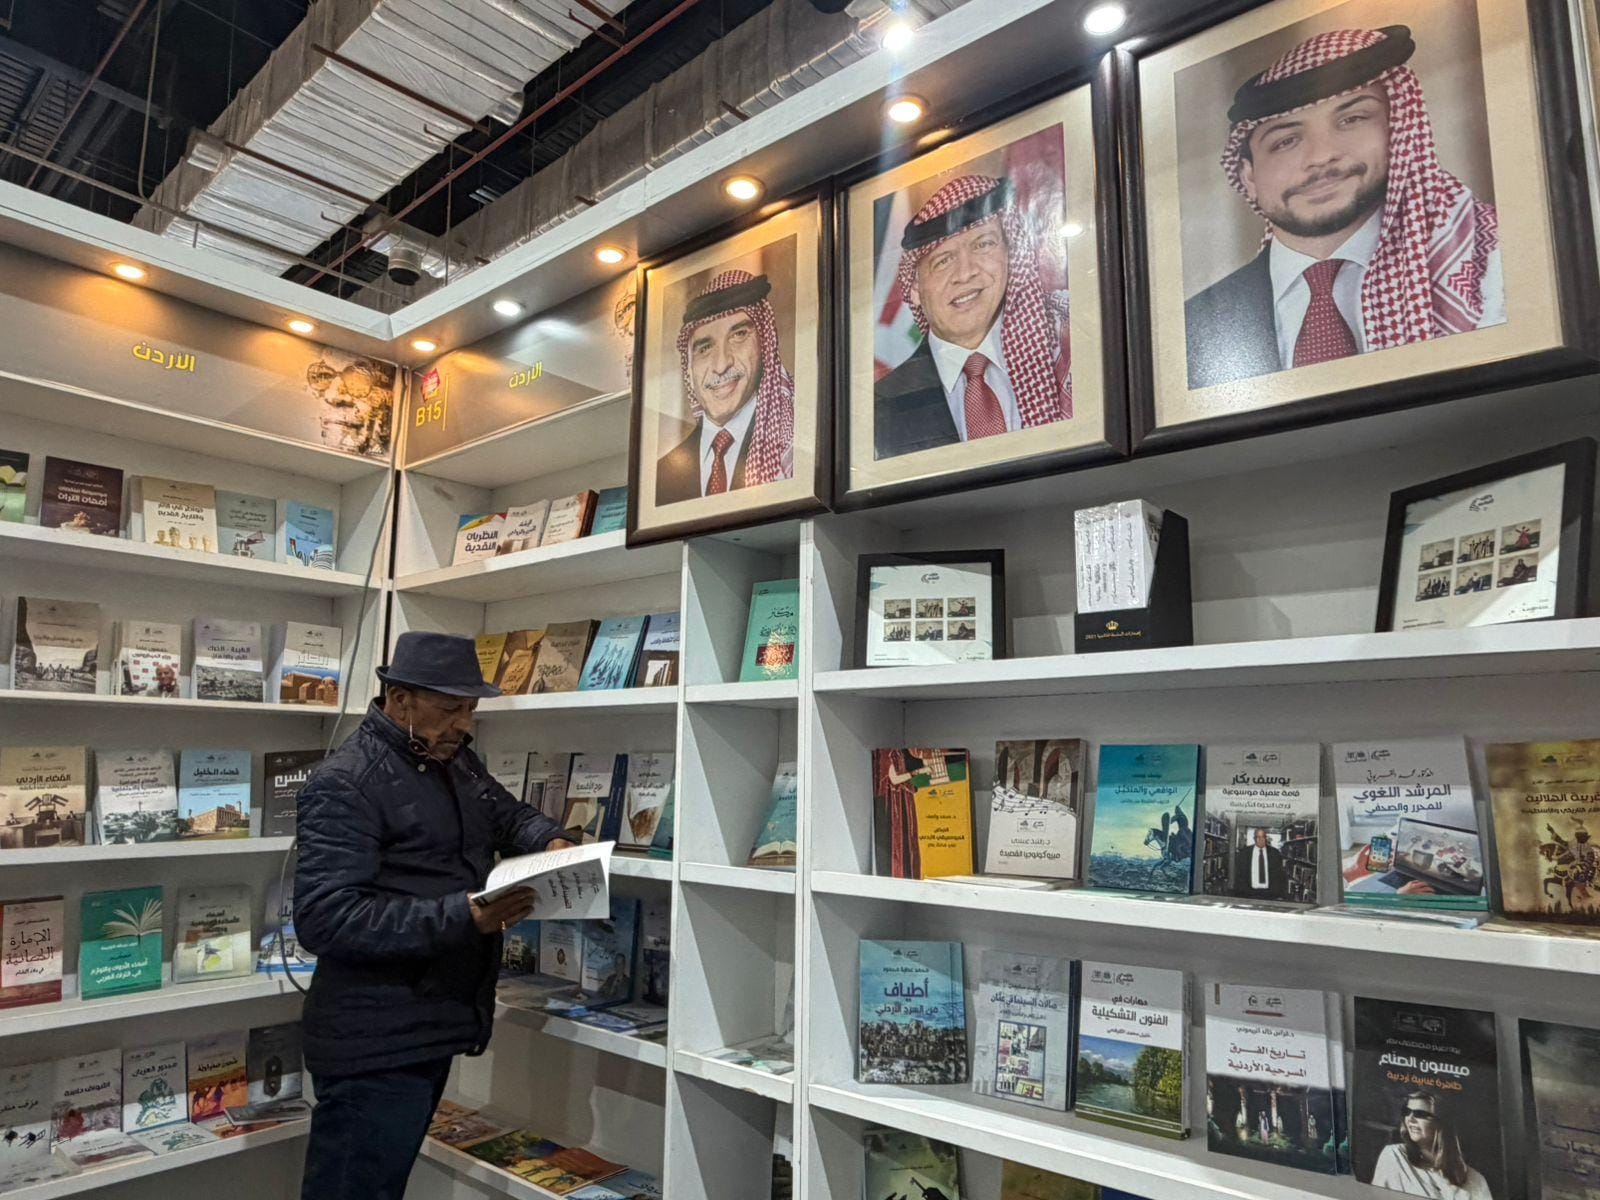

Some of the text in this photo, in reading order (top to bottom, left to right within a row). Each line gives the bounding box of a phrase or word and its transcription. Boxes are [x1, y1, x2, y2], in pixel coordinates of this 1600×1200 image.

[415, 400, 443, 428] B15
[466, 530, 498, 541] النظريات
[465, 541, 496, 554] النقدية
[1252, 776, 1291, 787] يوسف
[1148, 786, 1178, 797] الواقعي
[1353, 783, 1452, 803] المرشد اللغوي
[1525, 793, 1568, 804] الهلالية
[1411, 801, 1442, 812] للمحرر
[883, 977, 929, 1002] أطياف
[1112, 994, 1148, 1006] مهارات في
[925, 1005, 939, 1016] من
[1092, 1005, 1168, 1027] الفنون التشكيلية
[1227, 1058, 1307, 1078] المسرحية الأردنية
[1420, 1059, 1471, 1078] ميسون
